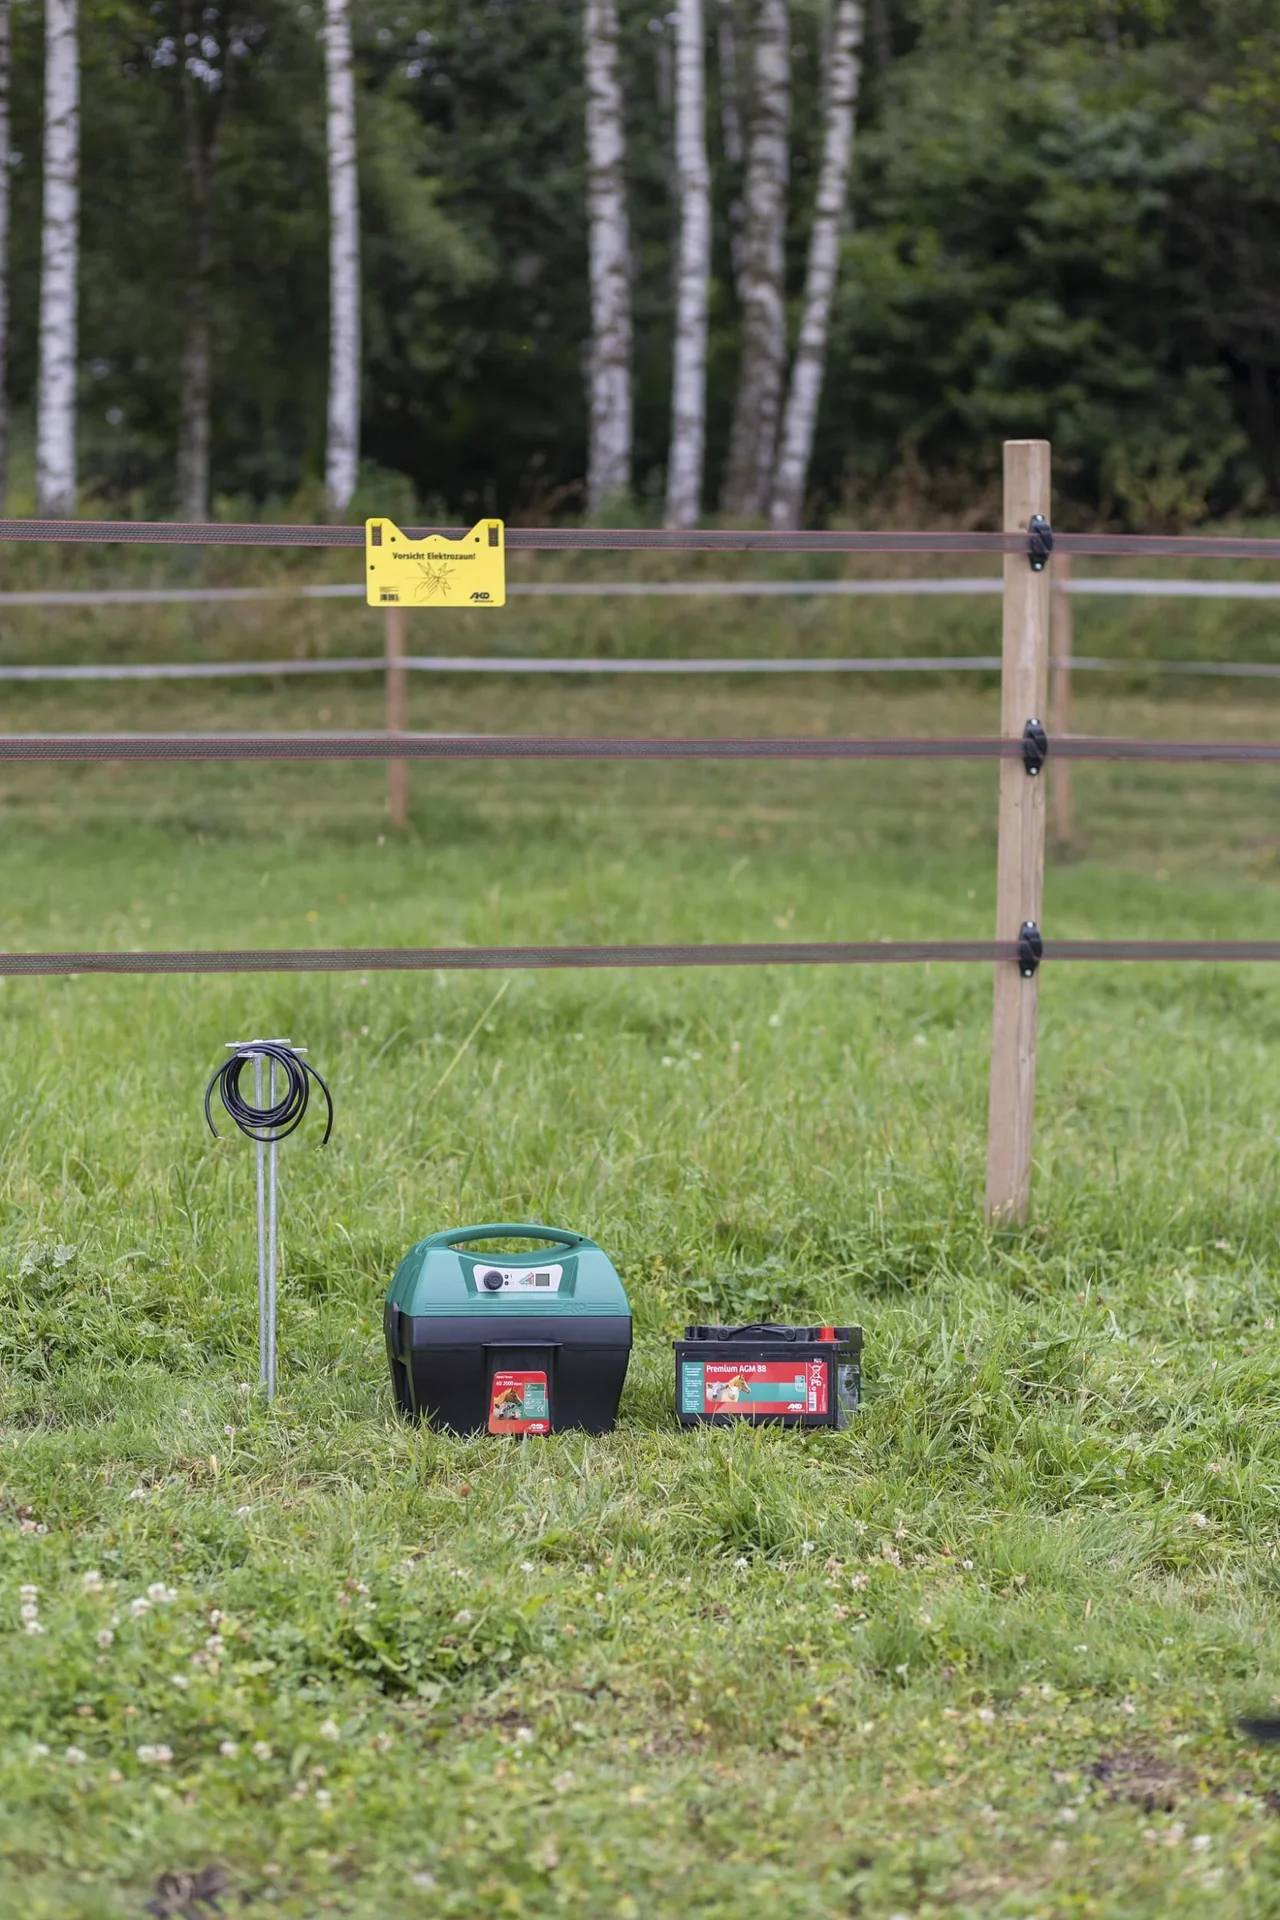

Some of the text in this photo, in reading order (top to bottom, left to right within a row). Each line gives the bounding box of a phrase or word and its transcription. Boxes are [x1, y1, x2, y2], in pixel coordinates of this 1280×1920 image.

[392, 552, 476, 560] Vorsicht Elektrozaun!
[706, 1364, 767, 1373] Premium AGM 88
[811, 1379, 822, 1387] Pb
